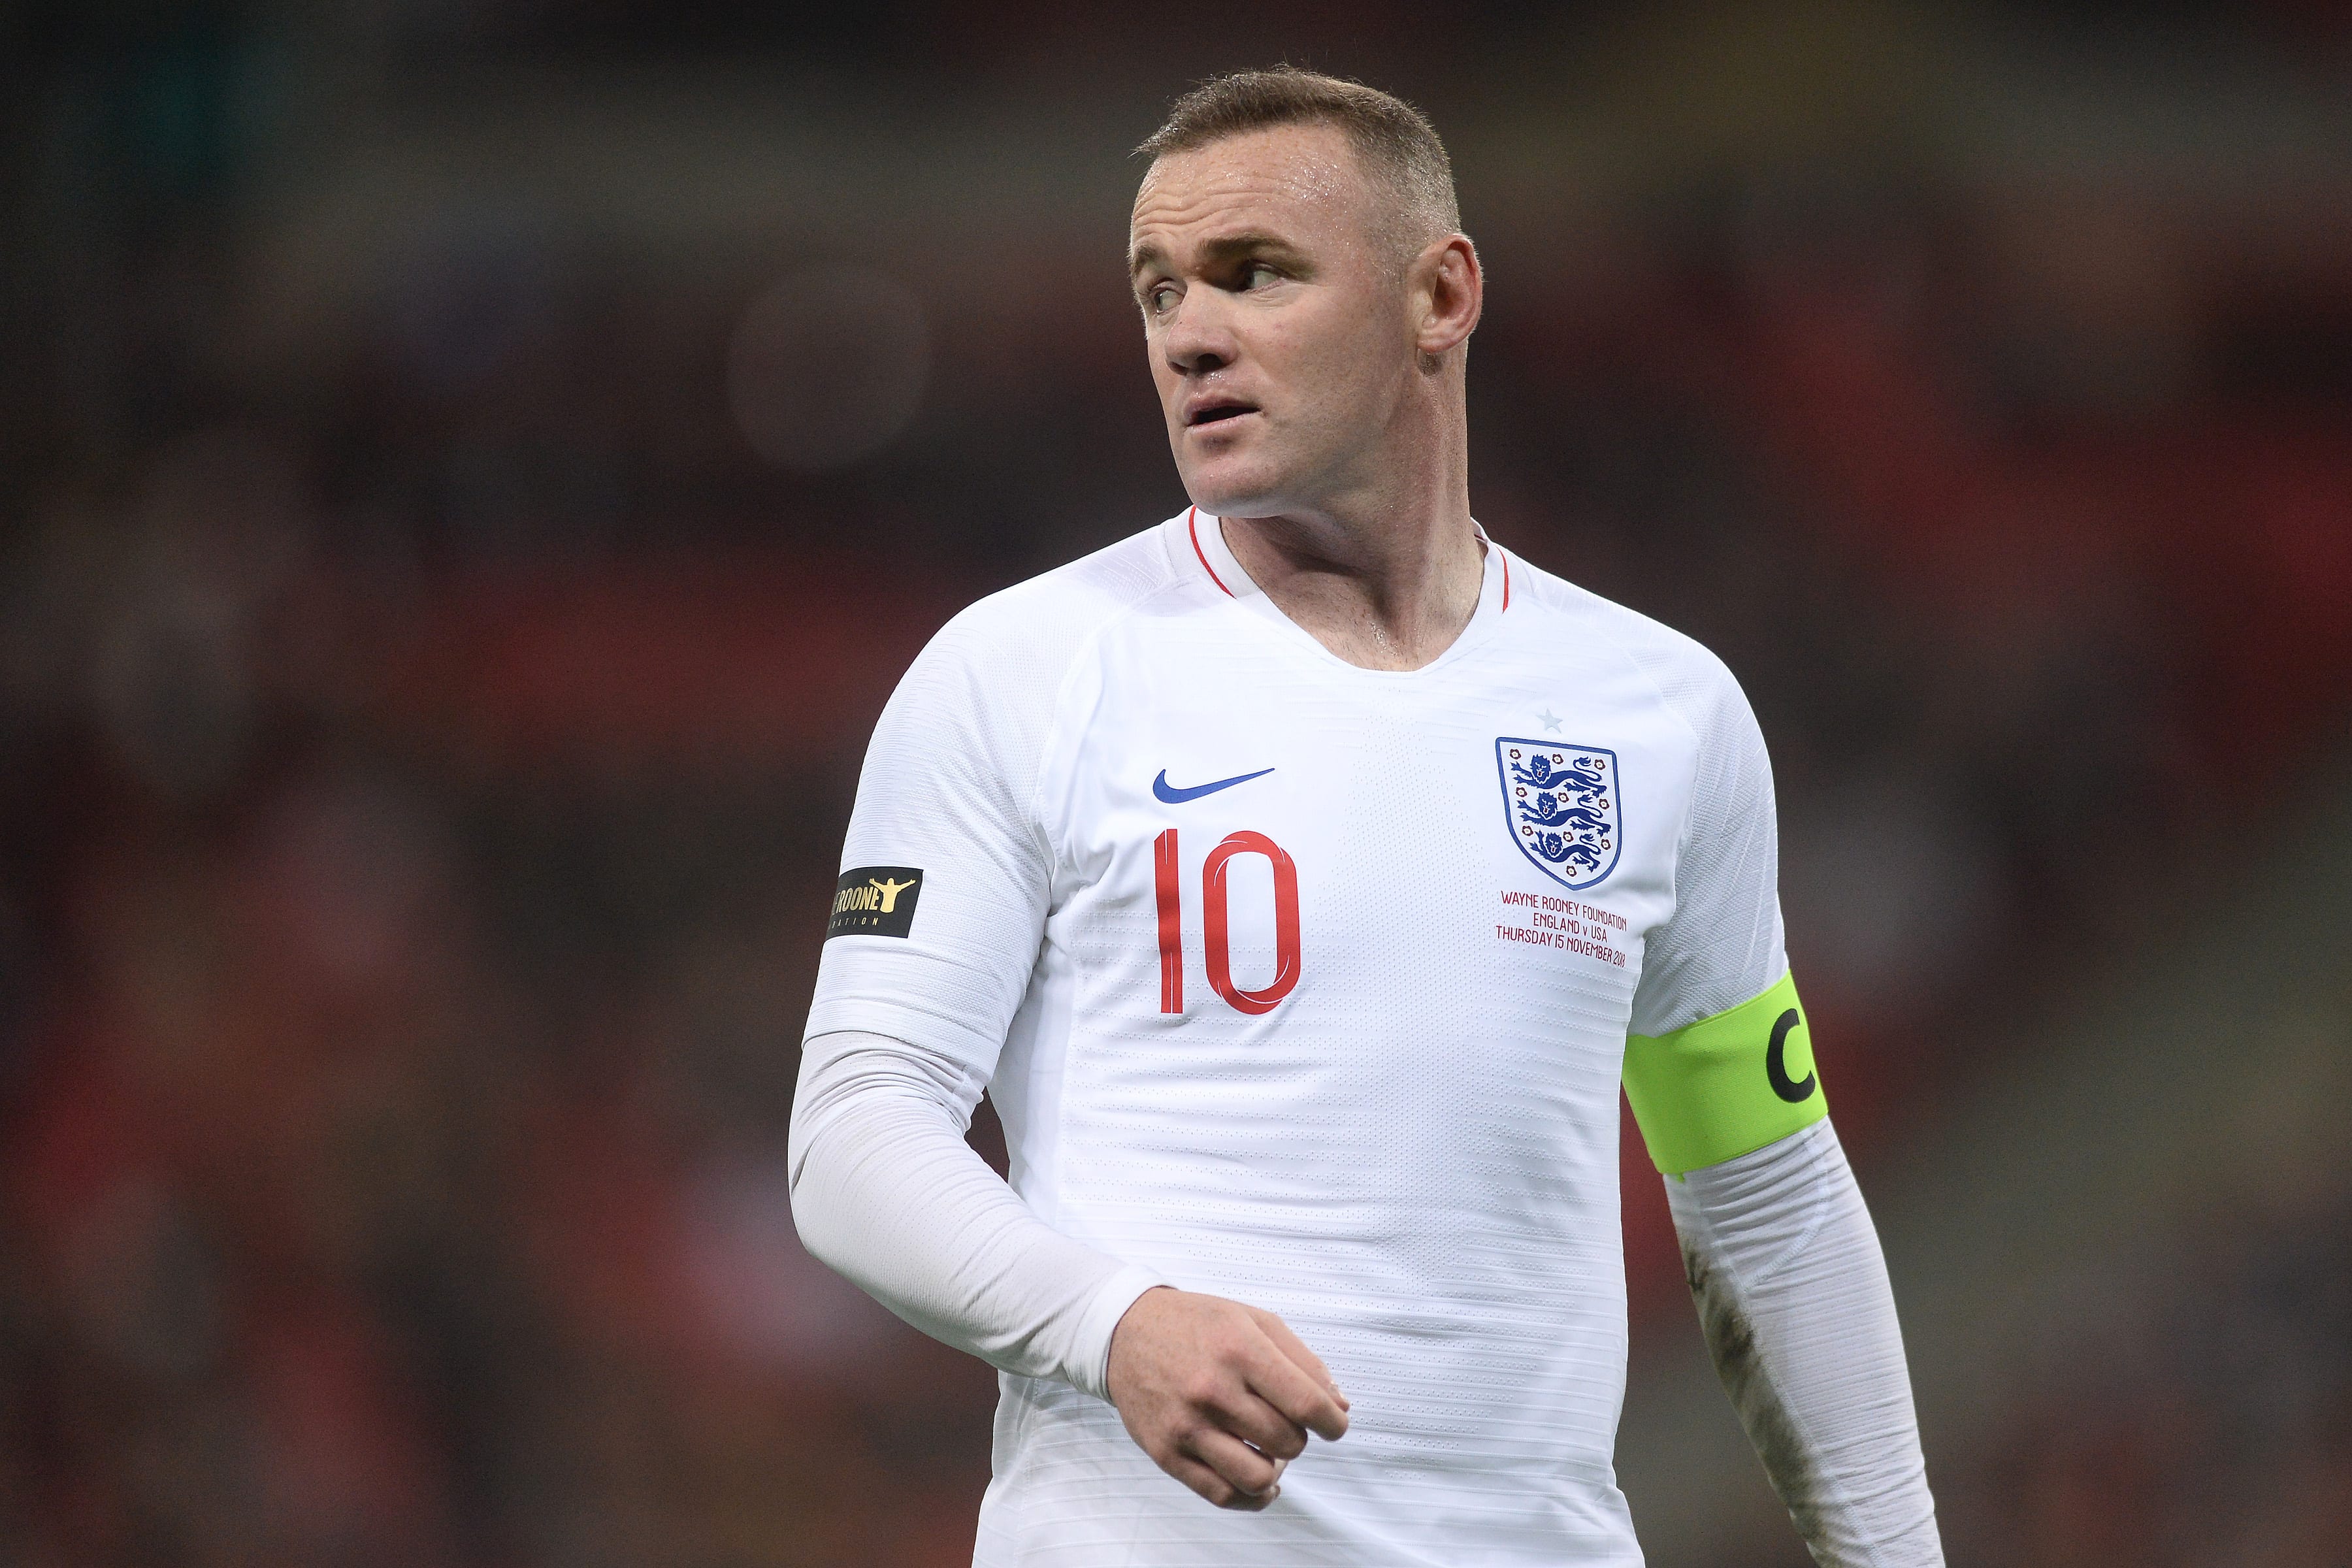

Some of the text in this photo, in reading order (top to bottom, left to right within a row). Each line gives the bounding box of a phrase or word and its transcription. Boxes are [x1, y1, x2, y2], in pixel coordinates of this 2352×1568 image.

[1154, 828, 1301, 1015] 10
[1501, 890, 1627, 932] WAYNE ROONEY FOUNDATION
[1533, 913, 1580, 934] ENGLAND
[1591, 924, 1607, 943] USA
[1496, 925, 1553, 947] THURSDAY
[1554, 934, 1565, 949] 15
[1566, 937, 1612, 963] NOVEMBER
[1766, 1008, 1816, 1103] C
